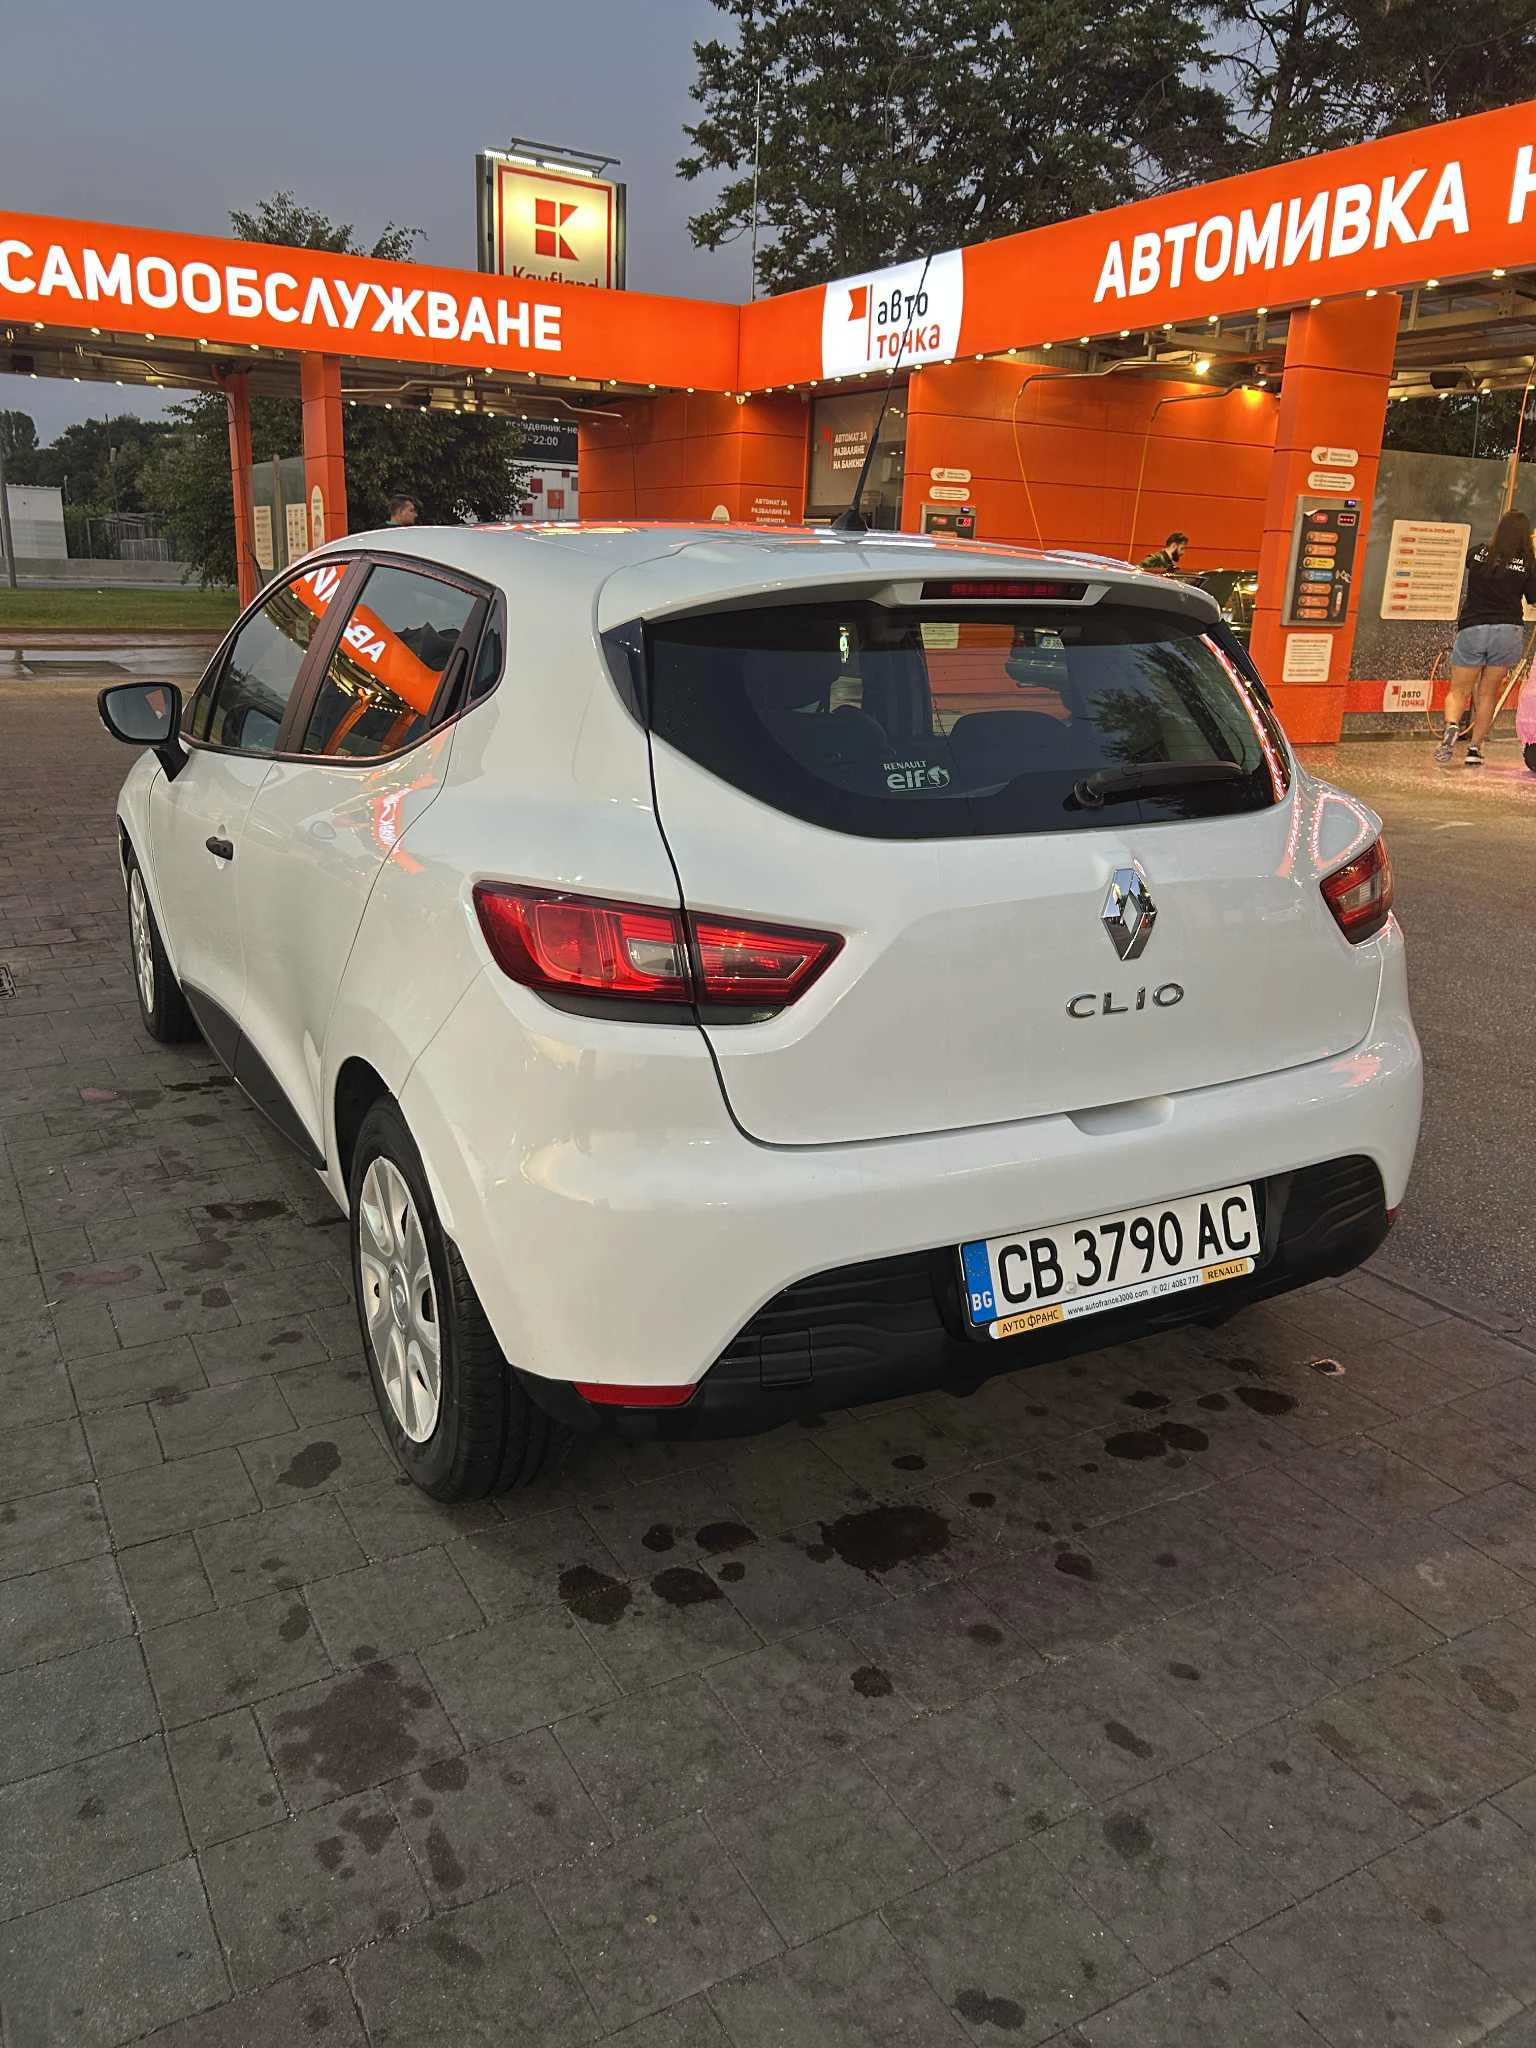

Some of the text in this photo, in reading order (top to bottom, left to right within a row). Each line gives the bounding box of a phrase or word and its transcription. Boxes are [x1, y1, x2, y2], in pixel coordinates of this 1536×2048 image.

[1093, 161, 1470, 303] АВТОМИВКА
[0, 239, 562, 351] САМООБСЛУЖВАНЕ
[877, 289, 929, 325] авто
[877, 324, 941, 359] точка
[882, 760, 927, 771] RENAULT
[886, 769, 926, 789] elf
[1065, 983, 1185, 1019] CLIO
[997, 1196, 1251, 1304] CB 3790 AC
[1207, 1263, 1245, 1280] RENAULT
[971, 1291, 993, 1312] BG
[1067, 1289, 1149, 1315] www.autofrance3000.com
[1002, 1309, 1059, 1333] АУТО ФРАНС
